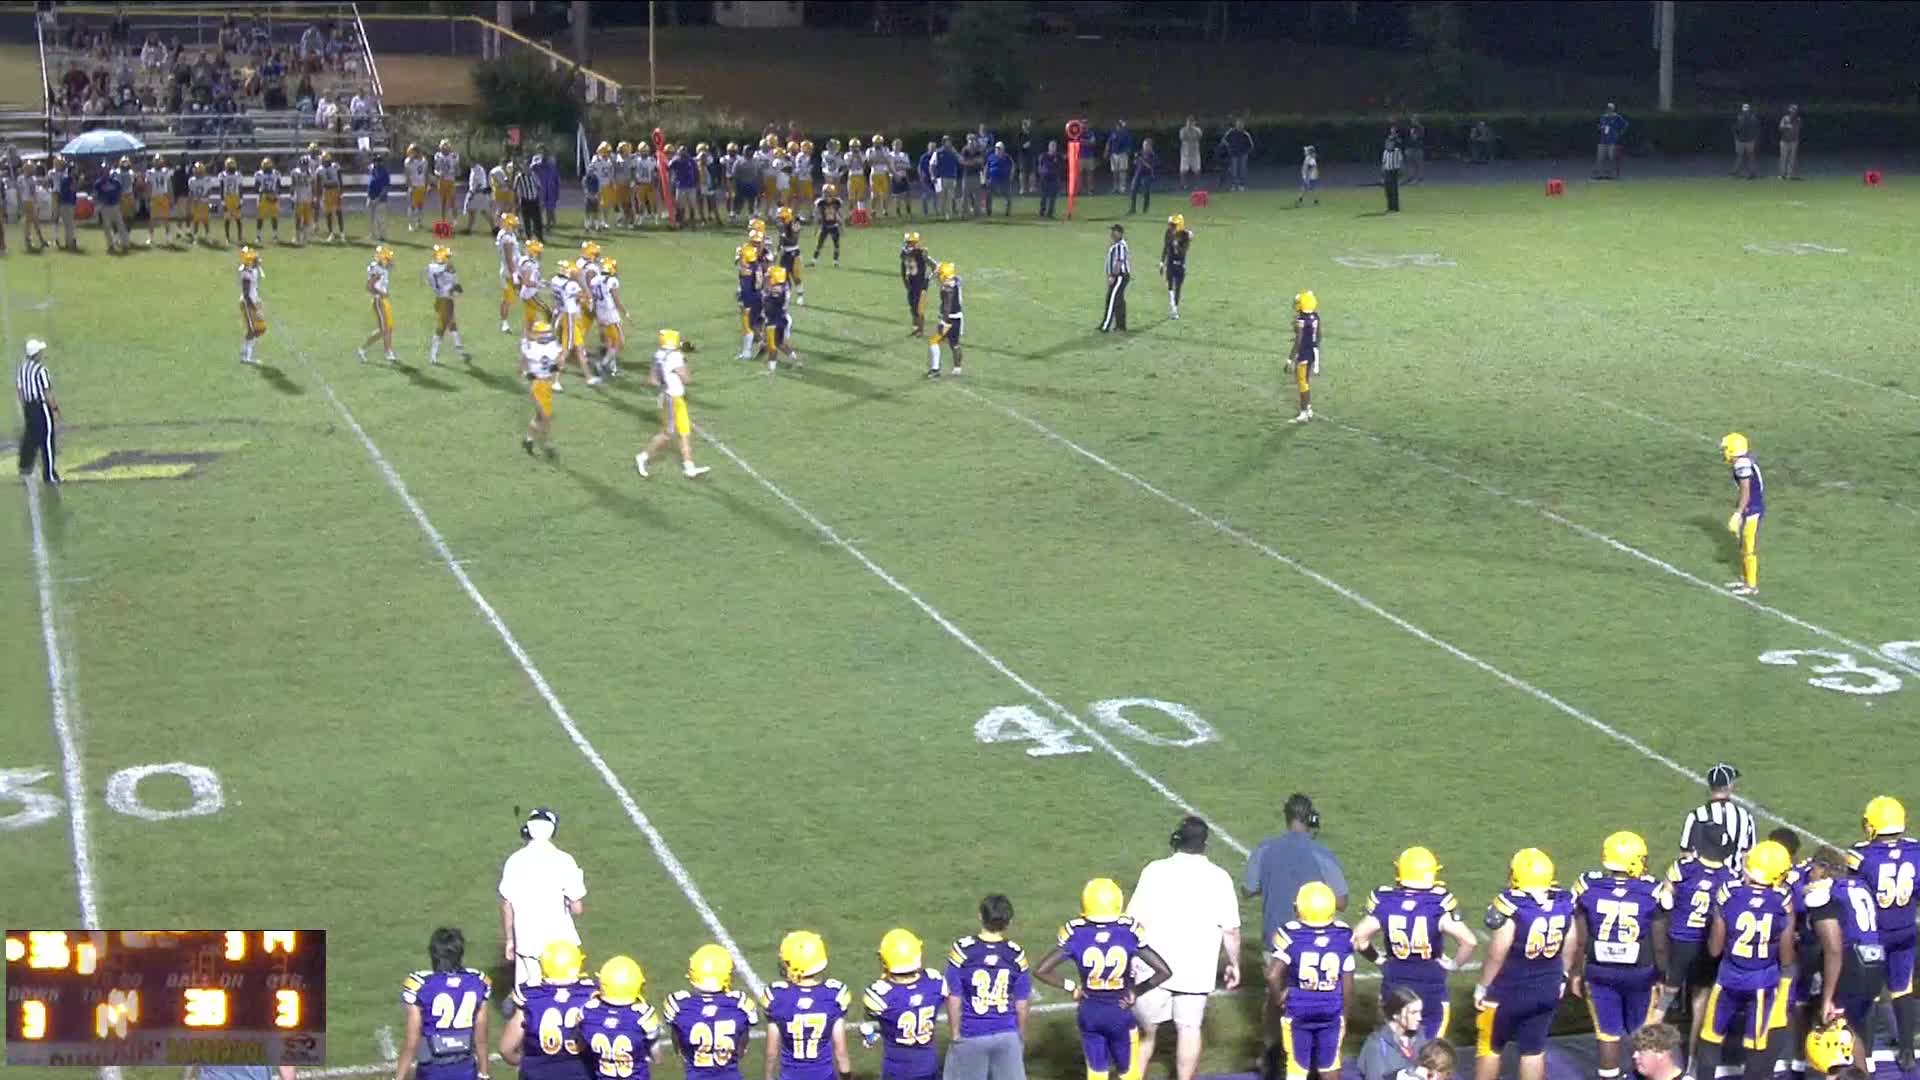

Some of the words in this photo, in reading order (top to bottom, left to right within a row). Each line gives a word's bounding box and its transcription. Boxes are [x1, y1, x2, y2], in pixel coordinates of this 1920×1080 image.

[973, 696, 1223, 757] 40
[1388, 915, 1432, 960] 54
[1525, 915, 1566, 959] 65
[1597, 899, 1640, 942] 75
[1732, 911, 1773, 958] 21
[1083, 946, 1127, 990] 22
[1299, 952, 1340, 991] 53
[971, 969, 1009, 1015] 34
[689, 1019, 736, 1067] 25
[787, 1013, 828, 1059] 17
[896, 1005, 935, 1045] 35
[591, 1032, 634, 1078] 26
